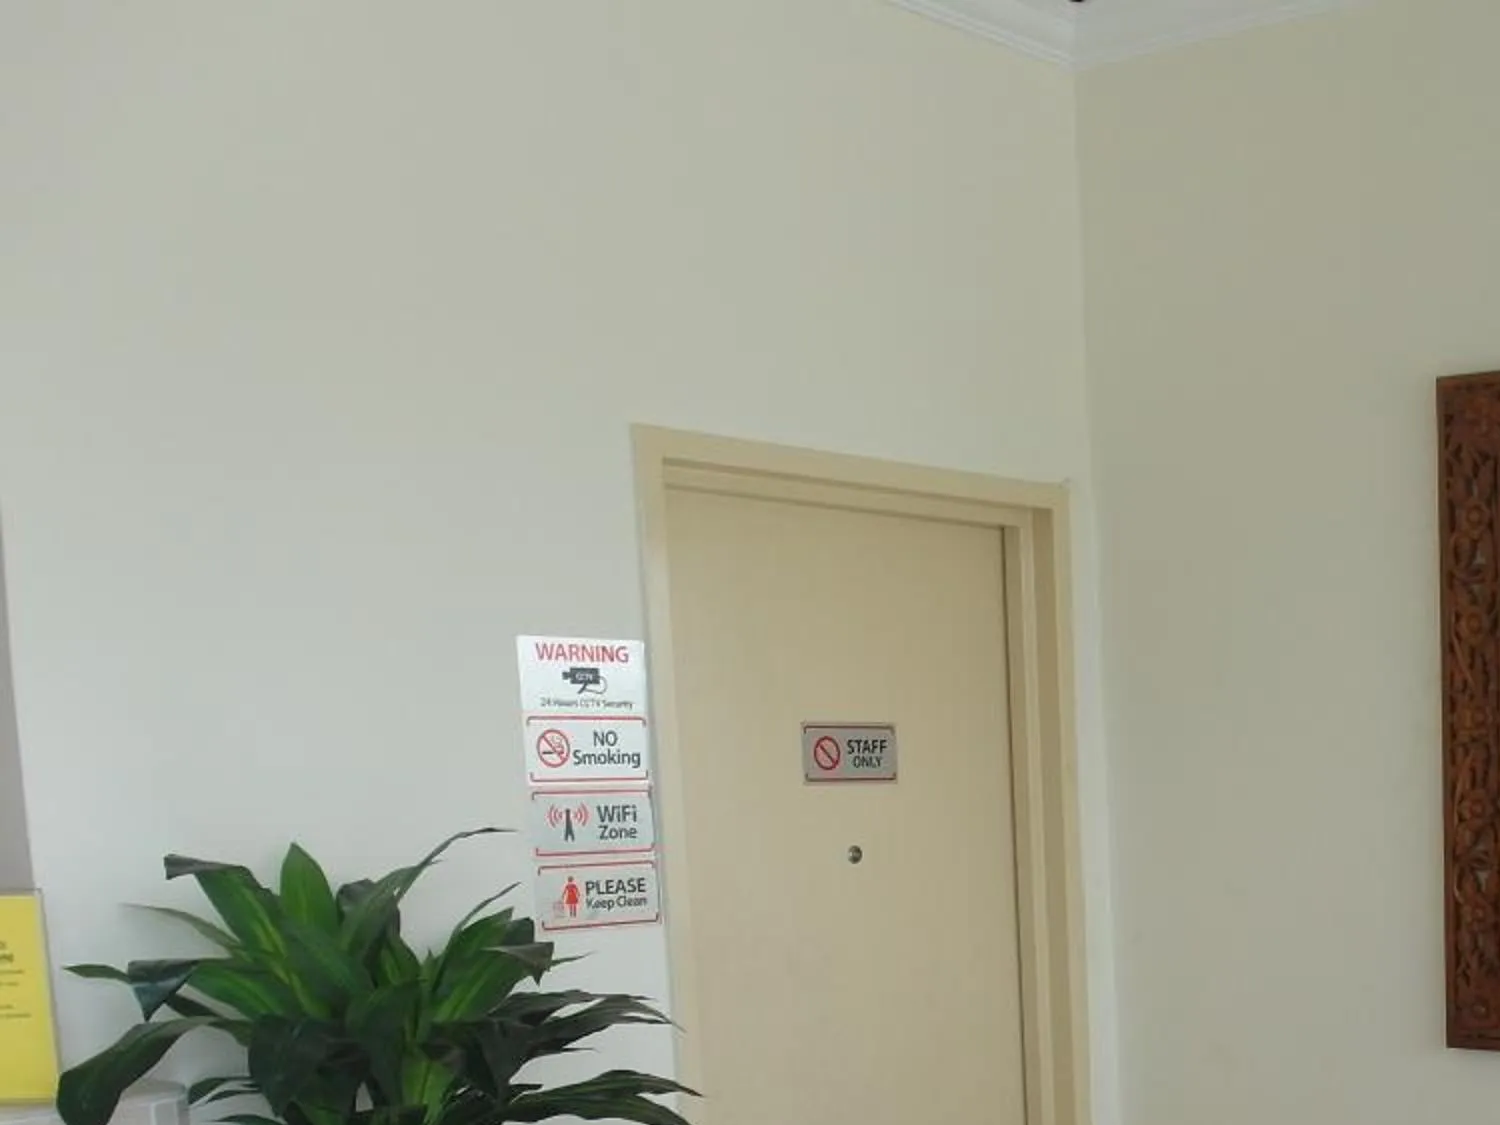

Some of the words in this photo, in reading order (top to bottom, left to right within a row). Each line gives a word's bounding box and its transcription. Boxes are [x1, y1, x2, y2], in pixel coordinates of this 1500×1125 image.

[535, 642, 630, 663] WARNING
[593, 730, 618, 747] NO
[846, 739, 888, 755] STAFF
[572, 749, 642, 769] Smoking
[852, 755, 883, 769] ONLY
[596, 804, 638, 823] WiFi
[598, 825, 638, 841] Zone
[585, 877, 647, 896] PLEASE
[586, 896, 616, 911] Keep
[617, 895, 647, 908] Clean
